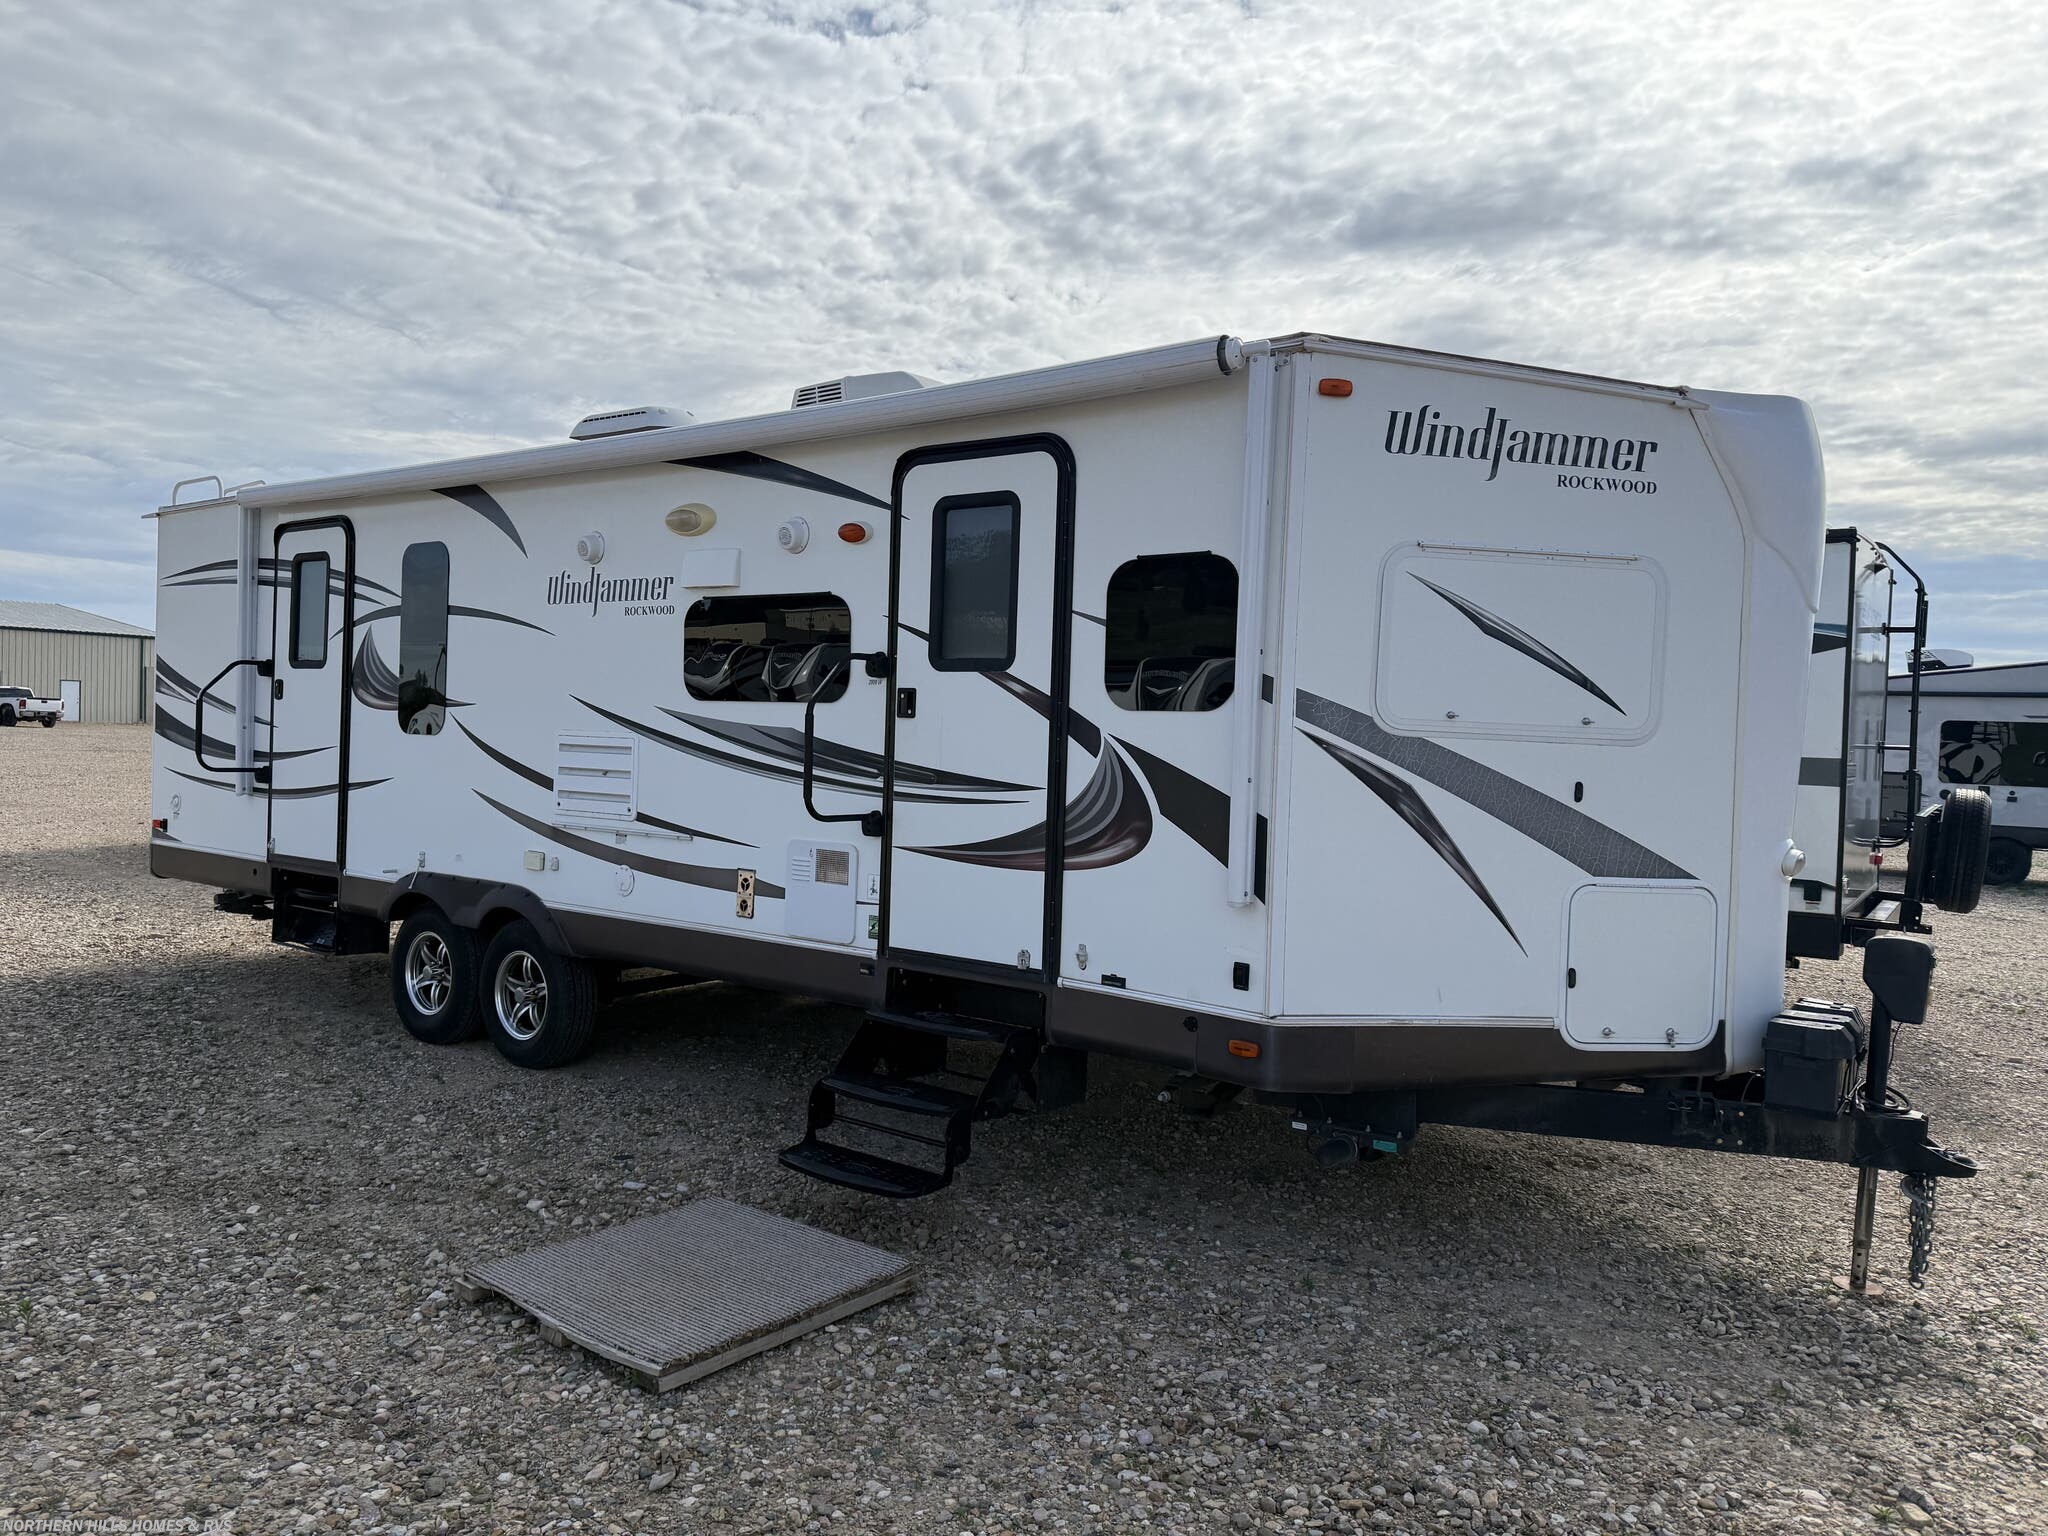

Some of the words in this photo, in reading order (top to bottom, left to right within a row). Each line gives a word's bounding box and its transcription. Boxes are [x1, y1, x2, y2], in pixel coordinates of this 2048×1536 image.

[1384, 404, 1658, 482] WindJammer
[1556, 474, 1658, 495] ROCKWOOD
[547, 566, 674, 618] WindJammer
[624, 605, 675, 616] ROCKWOOD
